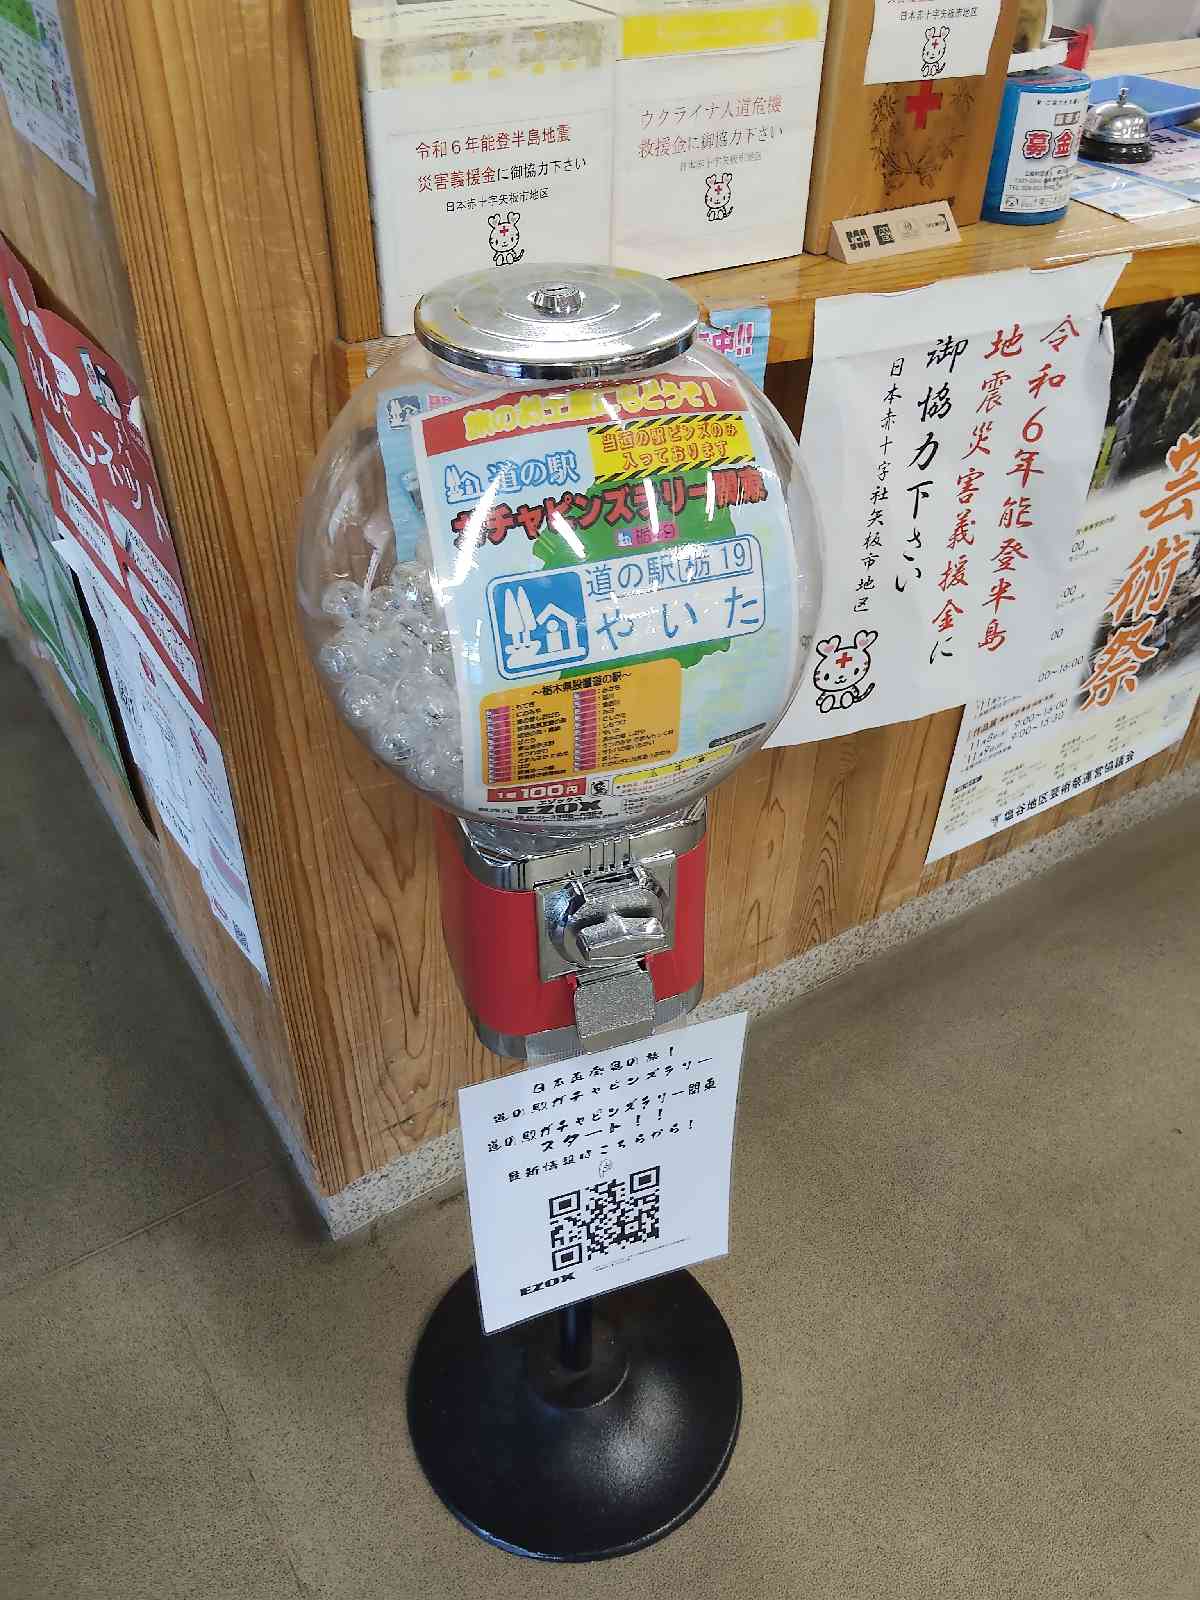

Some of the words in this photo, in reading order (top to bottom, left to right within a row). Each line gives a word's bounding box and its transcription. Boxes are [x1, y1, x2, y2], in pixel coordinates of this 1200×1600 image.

[640, 95, 783, 129] ウクライナ人道危機
[416, 124, 571, 160] 令和6年能登半島地震
[639, 126, 783, 158] 救援金に御協力下さい
[418, 157, 587, 192] 災害義援金に御協力下さい
[446, 187, 549, 212] 日本赤十字矢板市地区
[622, 440, 729, 470] 入っております
[896, 335, 968, 593] 御協力下さい
[853, 357, 904, 613] 日本赤十字社矢板市地区
[928, 323, 1024, 664] 地震災害義援金に
[978, 314, 1079, 652] 令和6年能登半島
[596, 586, 760, 651] やいた
[517, 799, 602, 815] EZOX
[493, 1057, 712, 1123] 道の駅ガチャピンズラリー
[488, 1077, 717, 1153] 道の駅ガチャピンズラリー関東
[508, 1120, 693, 1182] 最新情報はこちらから!
[520, 1272, 576, 1296] EZOX
